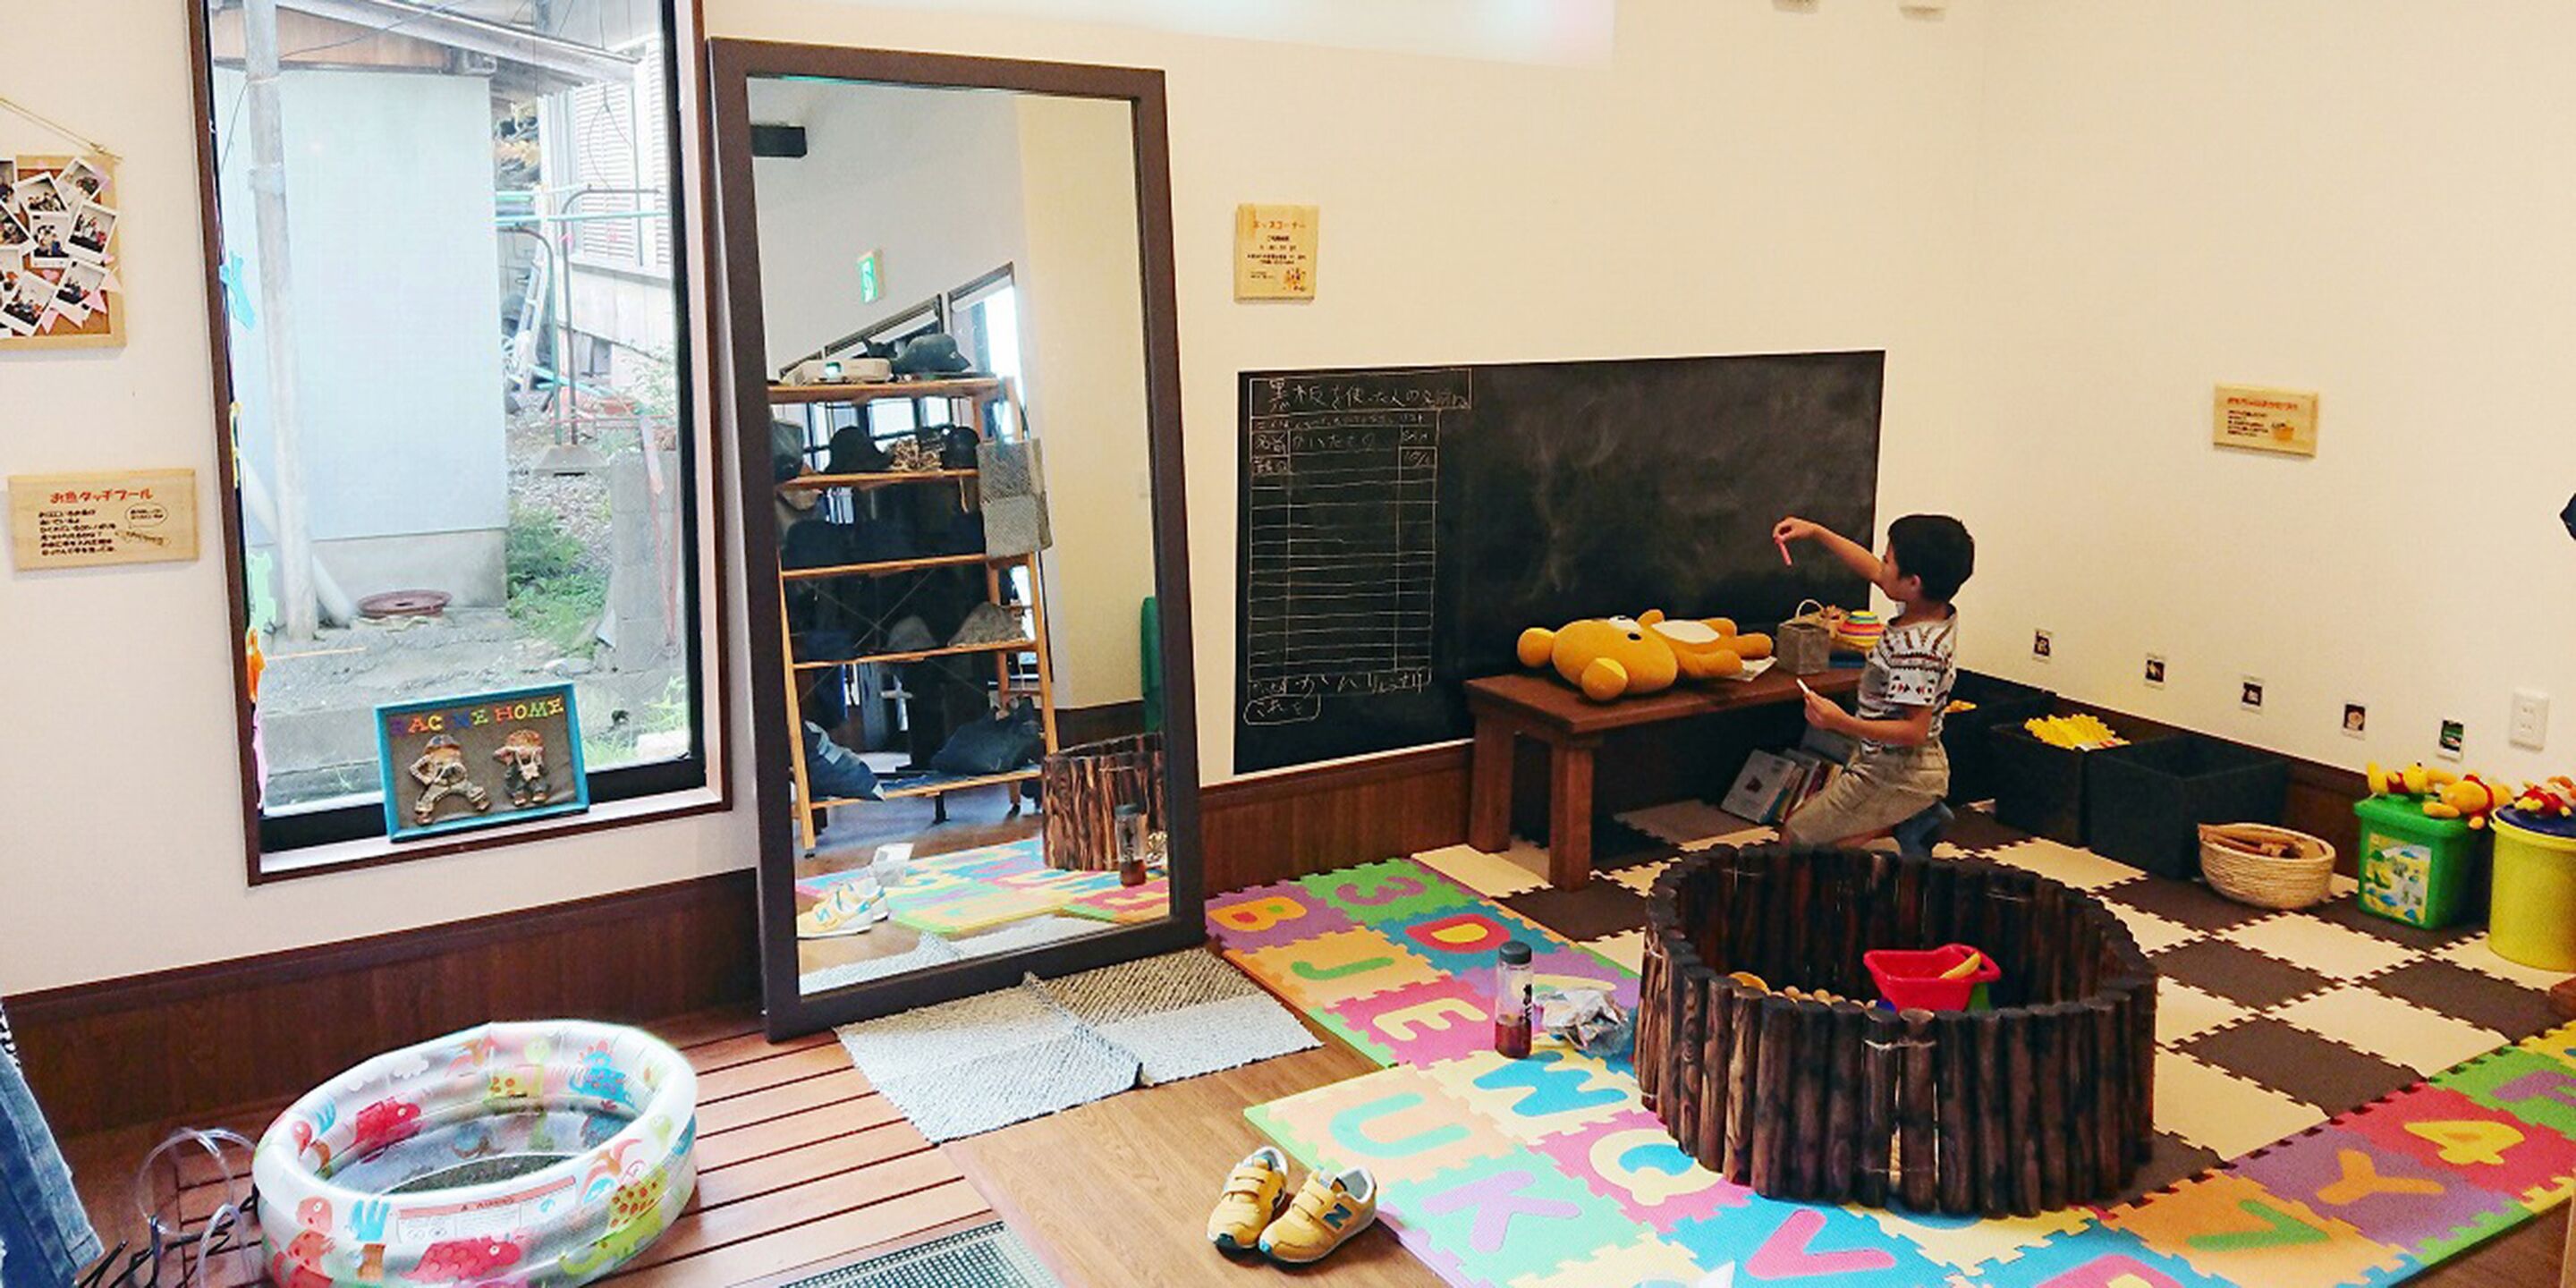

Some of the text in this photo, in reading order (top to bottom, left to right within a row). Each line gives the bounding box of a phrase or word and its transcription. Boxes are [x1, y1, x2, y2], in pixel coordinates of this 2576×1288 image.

[494, 698, 564, 724] HOME
[1208, 896, 1308, 932] B
[1404, 913, 1512, 954] D
[1291, 956, 1394, 981] J
[1373, 997, 1488, 1043] E
[1472, 1050, 1628, 1116] W
[1329, 1092, 1470, 1157] U
[2403, 1119, 2526, 1165] 4
[2316, 1148, 2445, 1206] Y
[1323, 1202, 1353, 1230] N
[1420, 1170, 1582, 1253] K
[1745, 1208, 1896, 1280] V
